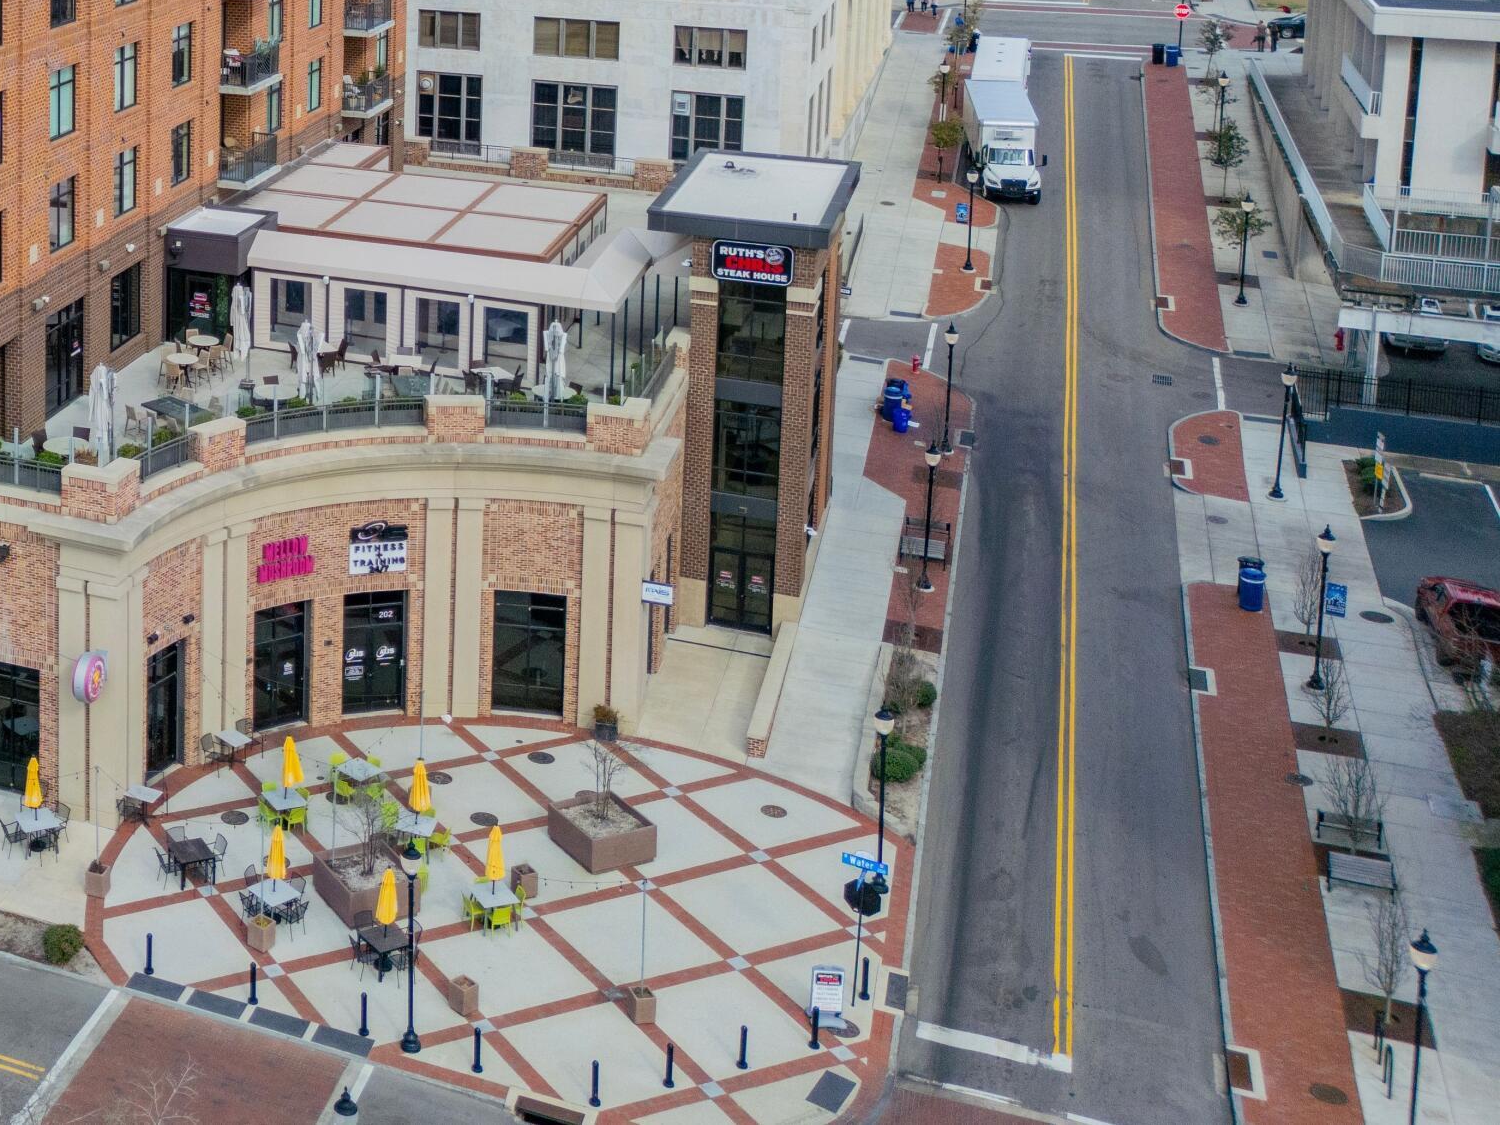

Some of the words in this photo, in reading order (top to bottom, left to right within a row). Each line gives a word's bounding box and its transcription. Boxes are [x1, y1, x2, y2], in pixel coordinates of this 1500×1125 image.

[720, 246, 765, 259] RUTH'S
[725, 256, 785, 274] CHRIS
[717, 268, 751, 278] STEAK
[753, 272, 788, 282] HOUSE
[262, 535, 309, 562] MELLOW
[354, 542, 405, 553] FITNESS
[257, 555, 315, 583] MUSHROOM
[353, 557, 406, 567] TRAINING
[850, 855, 874, 870] Water
